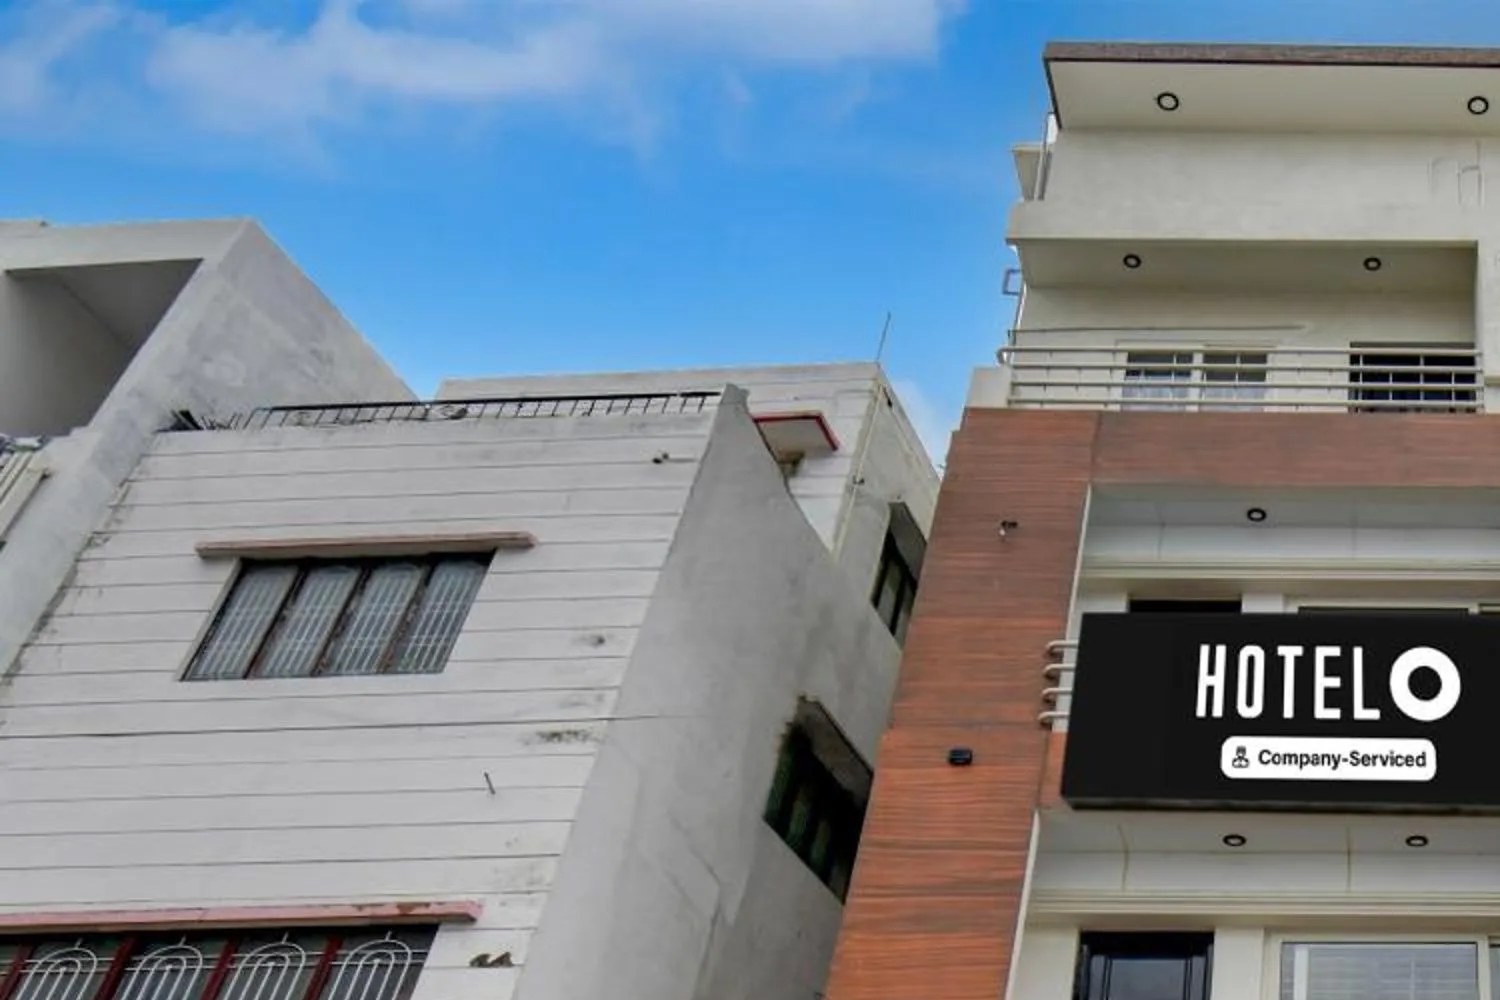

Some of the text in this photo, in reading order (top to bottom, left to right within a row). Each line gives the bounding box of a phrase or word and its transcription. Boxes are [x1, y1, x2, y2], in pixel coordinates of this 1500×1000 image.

[1195, 643, 1461, 722] HOTEL O
[1258, 749, 1427, 771] Company-Serviced
